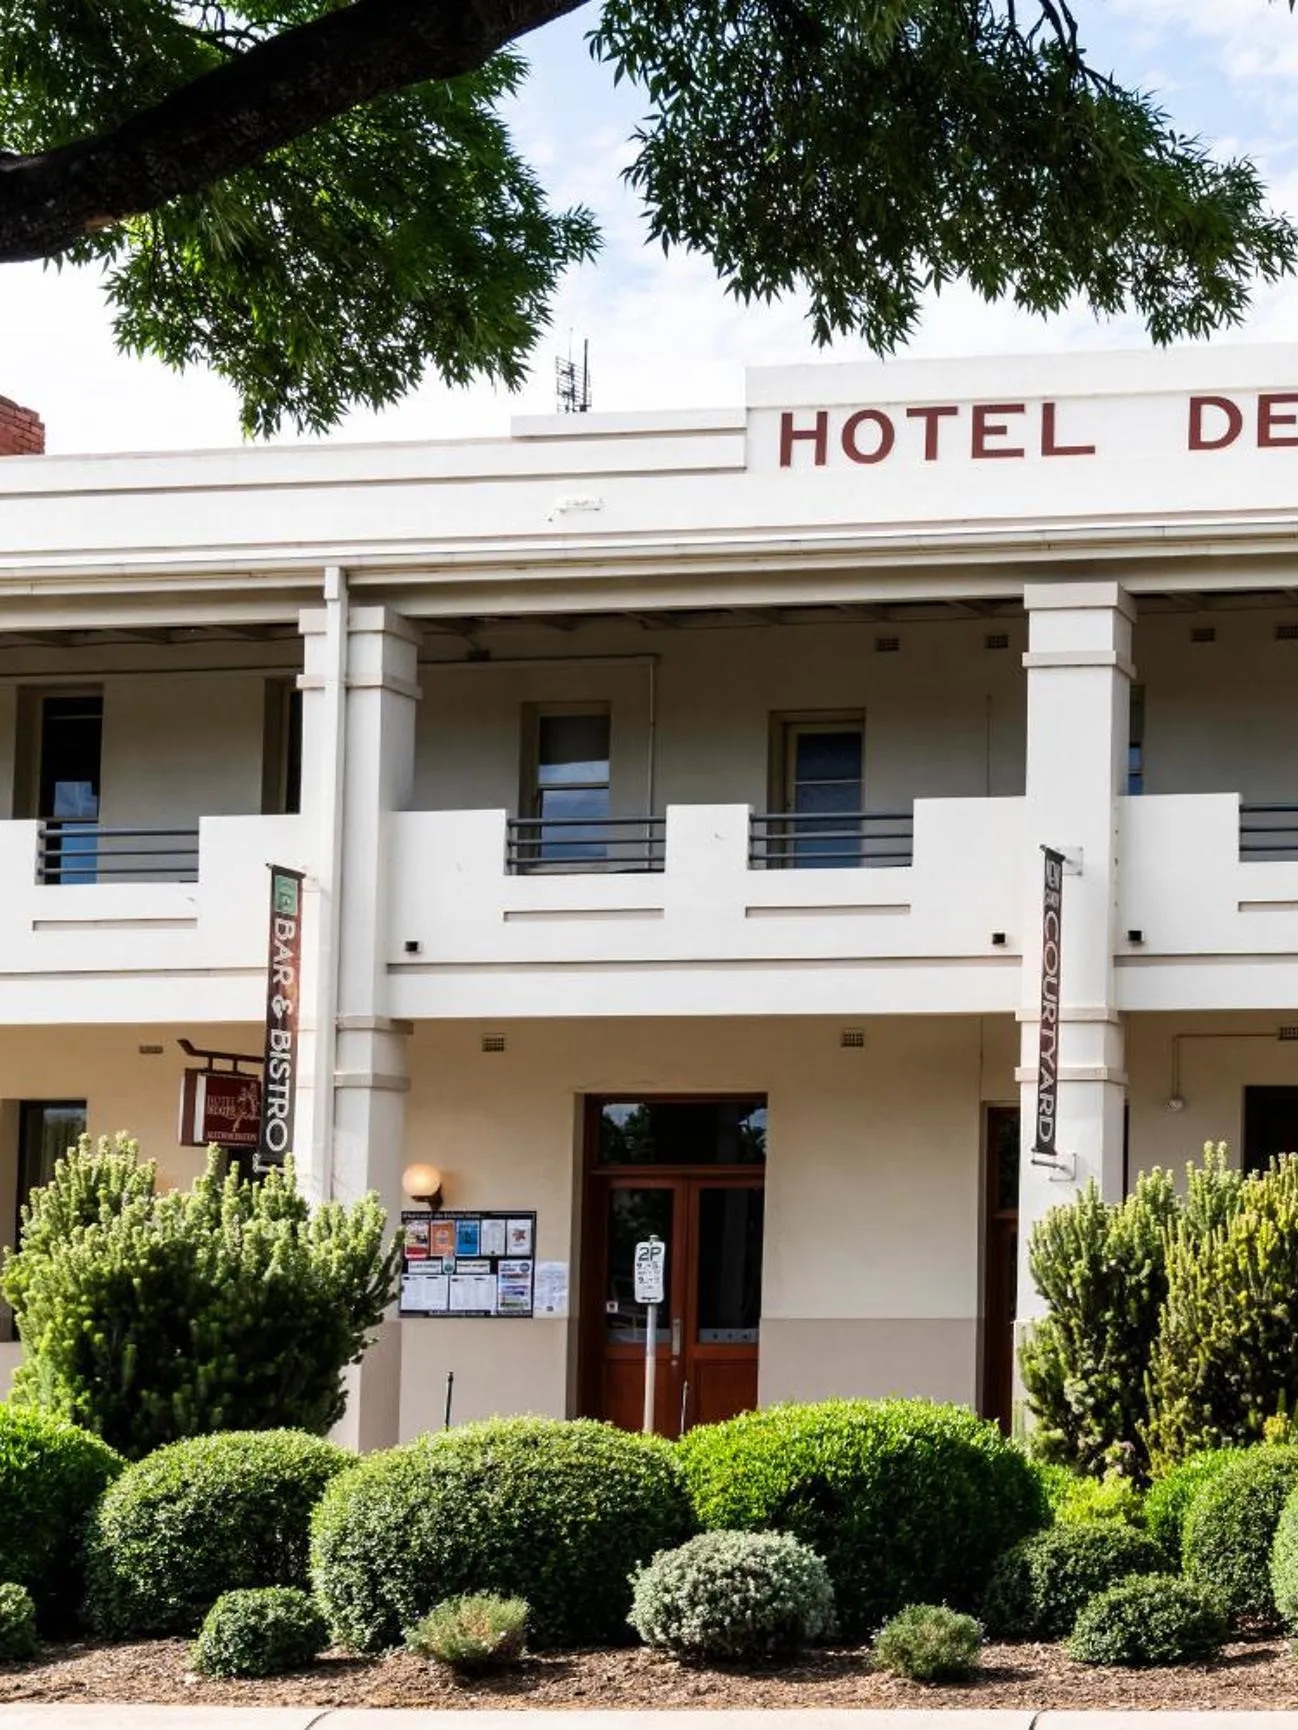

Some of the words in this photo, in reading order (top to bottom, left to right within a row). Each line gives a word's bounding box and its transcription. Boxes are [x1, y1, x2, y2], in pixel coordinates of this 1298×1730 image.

[779, 403, 1096, 467] HOTEL
[272, 918, 296, 984] BAR
[271, 994, 293, 1019] &
[1040, 911, 1059, 1142] COURTYARD
[266, 1029, 291, 1152] BISTRO
[638, 1246, 662, 1262] 2P
